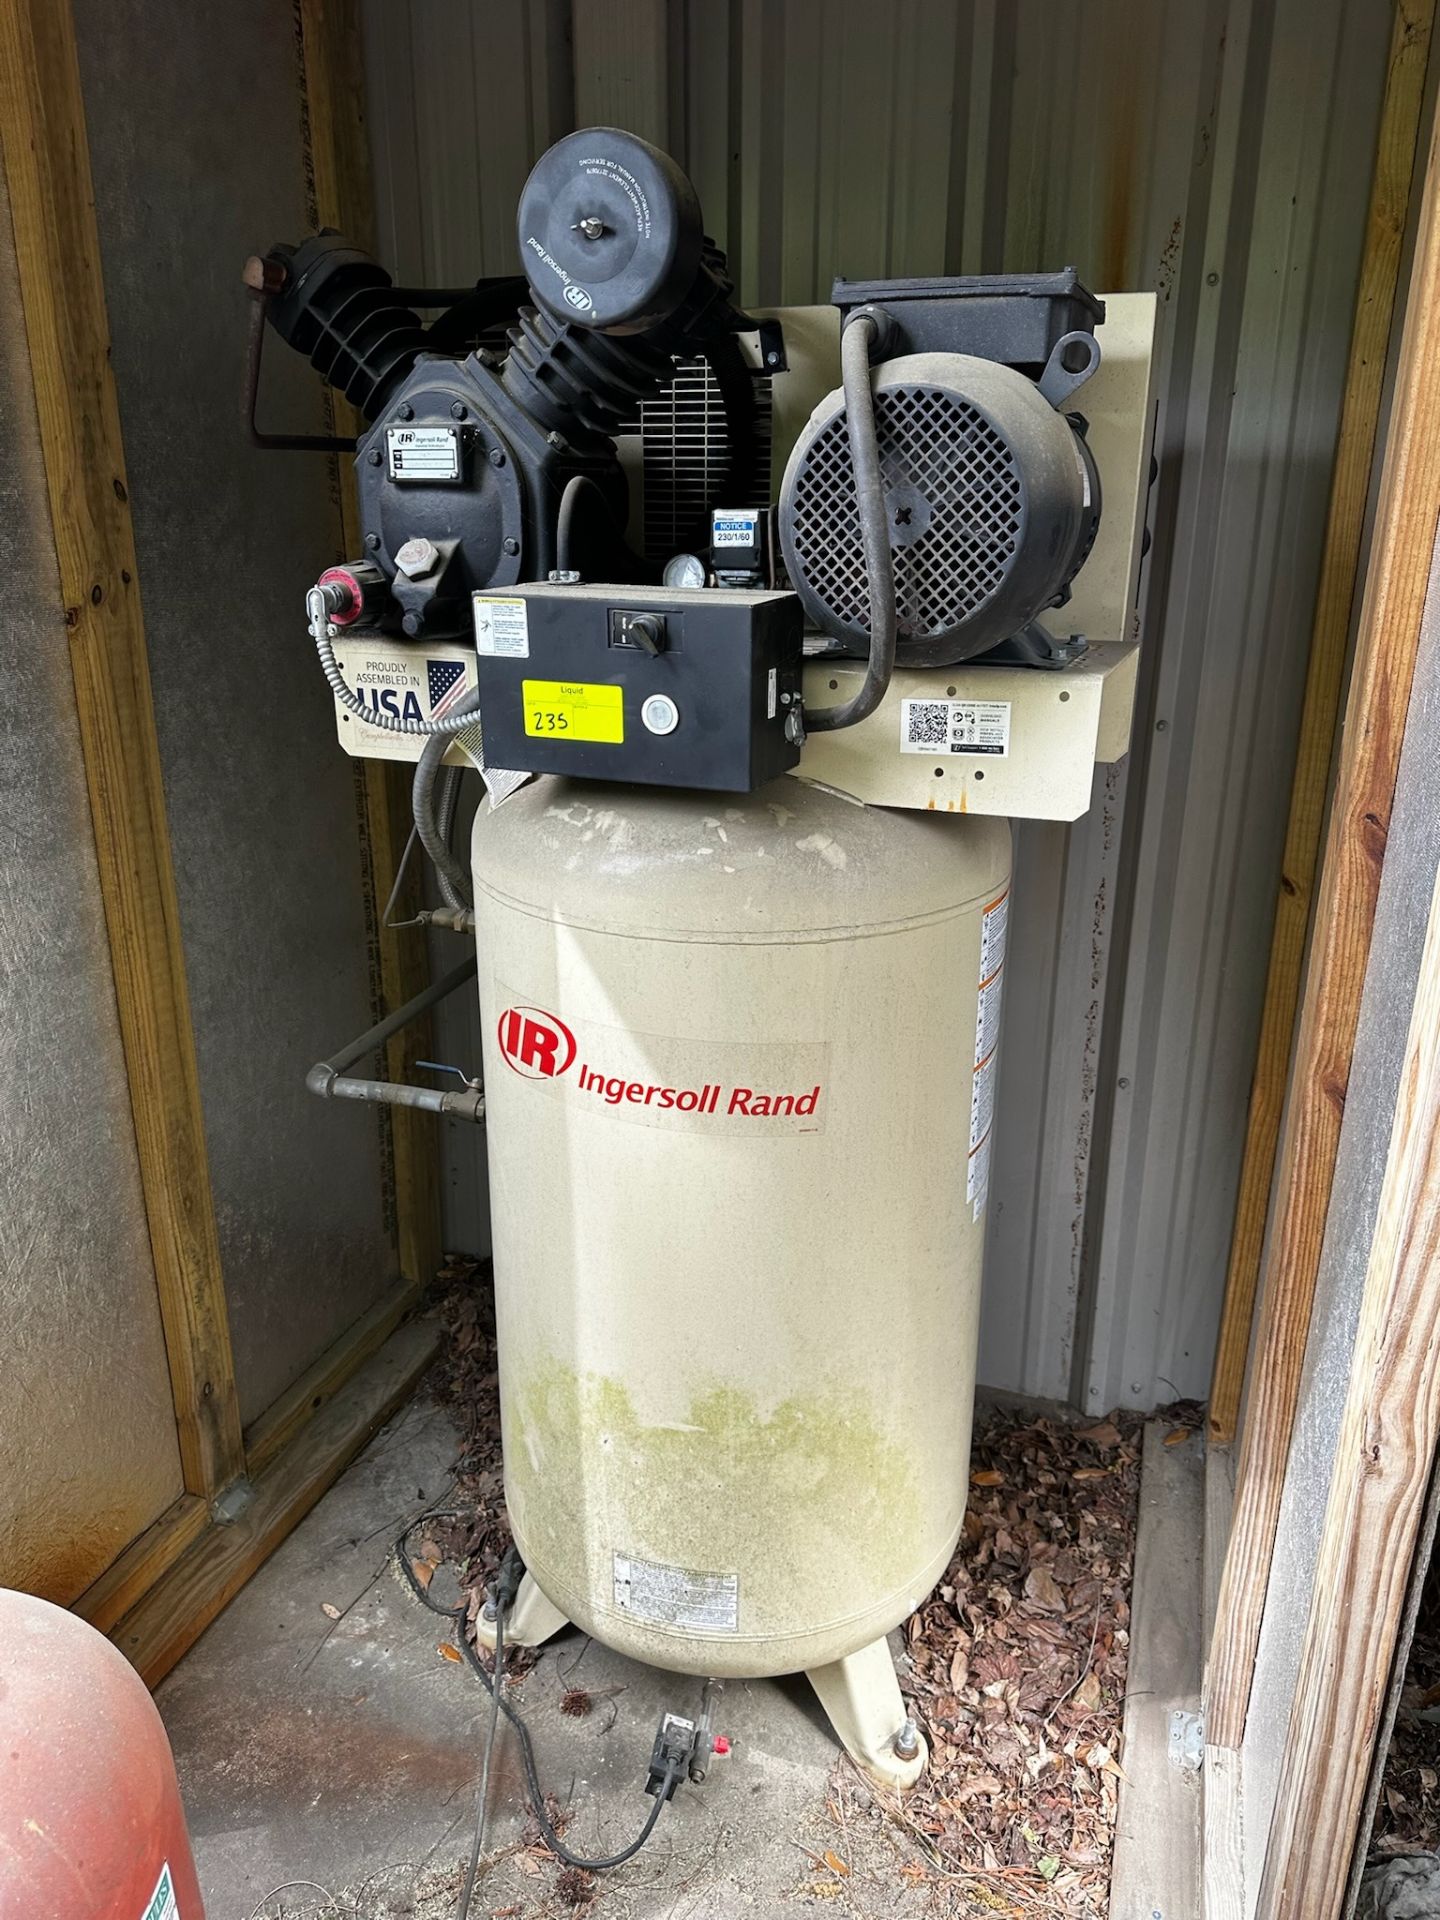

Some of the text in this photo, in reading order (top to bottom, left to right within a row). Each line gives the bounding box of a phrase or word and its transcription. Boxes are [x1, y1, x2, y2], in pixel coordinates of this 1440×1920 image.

[606, 161, 617, 169] FOR
[618, 165, 636, 184] MANUAL
[608, 172, 630, 191] ELEMENT
[627, 189, 643, 232] REPLACEMENT
[526, 237, 591, 310] IR Ingersoll Rand
[400, 433, 413, 443] IR
[720, 522, 747, 530] NOTICE
[718, 533, 750, 541] 230/1/60
[366, 661, 408, 673] PROUDLY
[356, 673, 420, 686] ASSEMBLED IN
[560, 686, 584, 695] Liquid
[533, 712, 568, 730] 235
[505, 1007, 821, 1117] IR Ingersoll Rand
